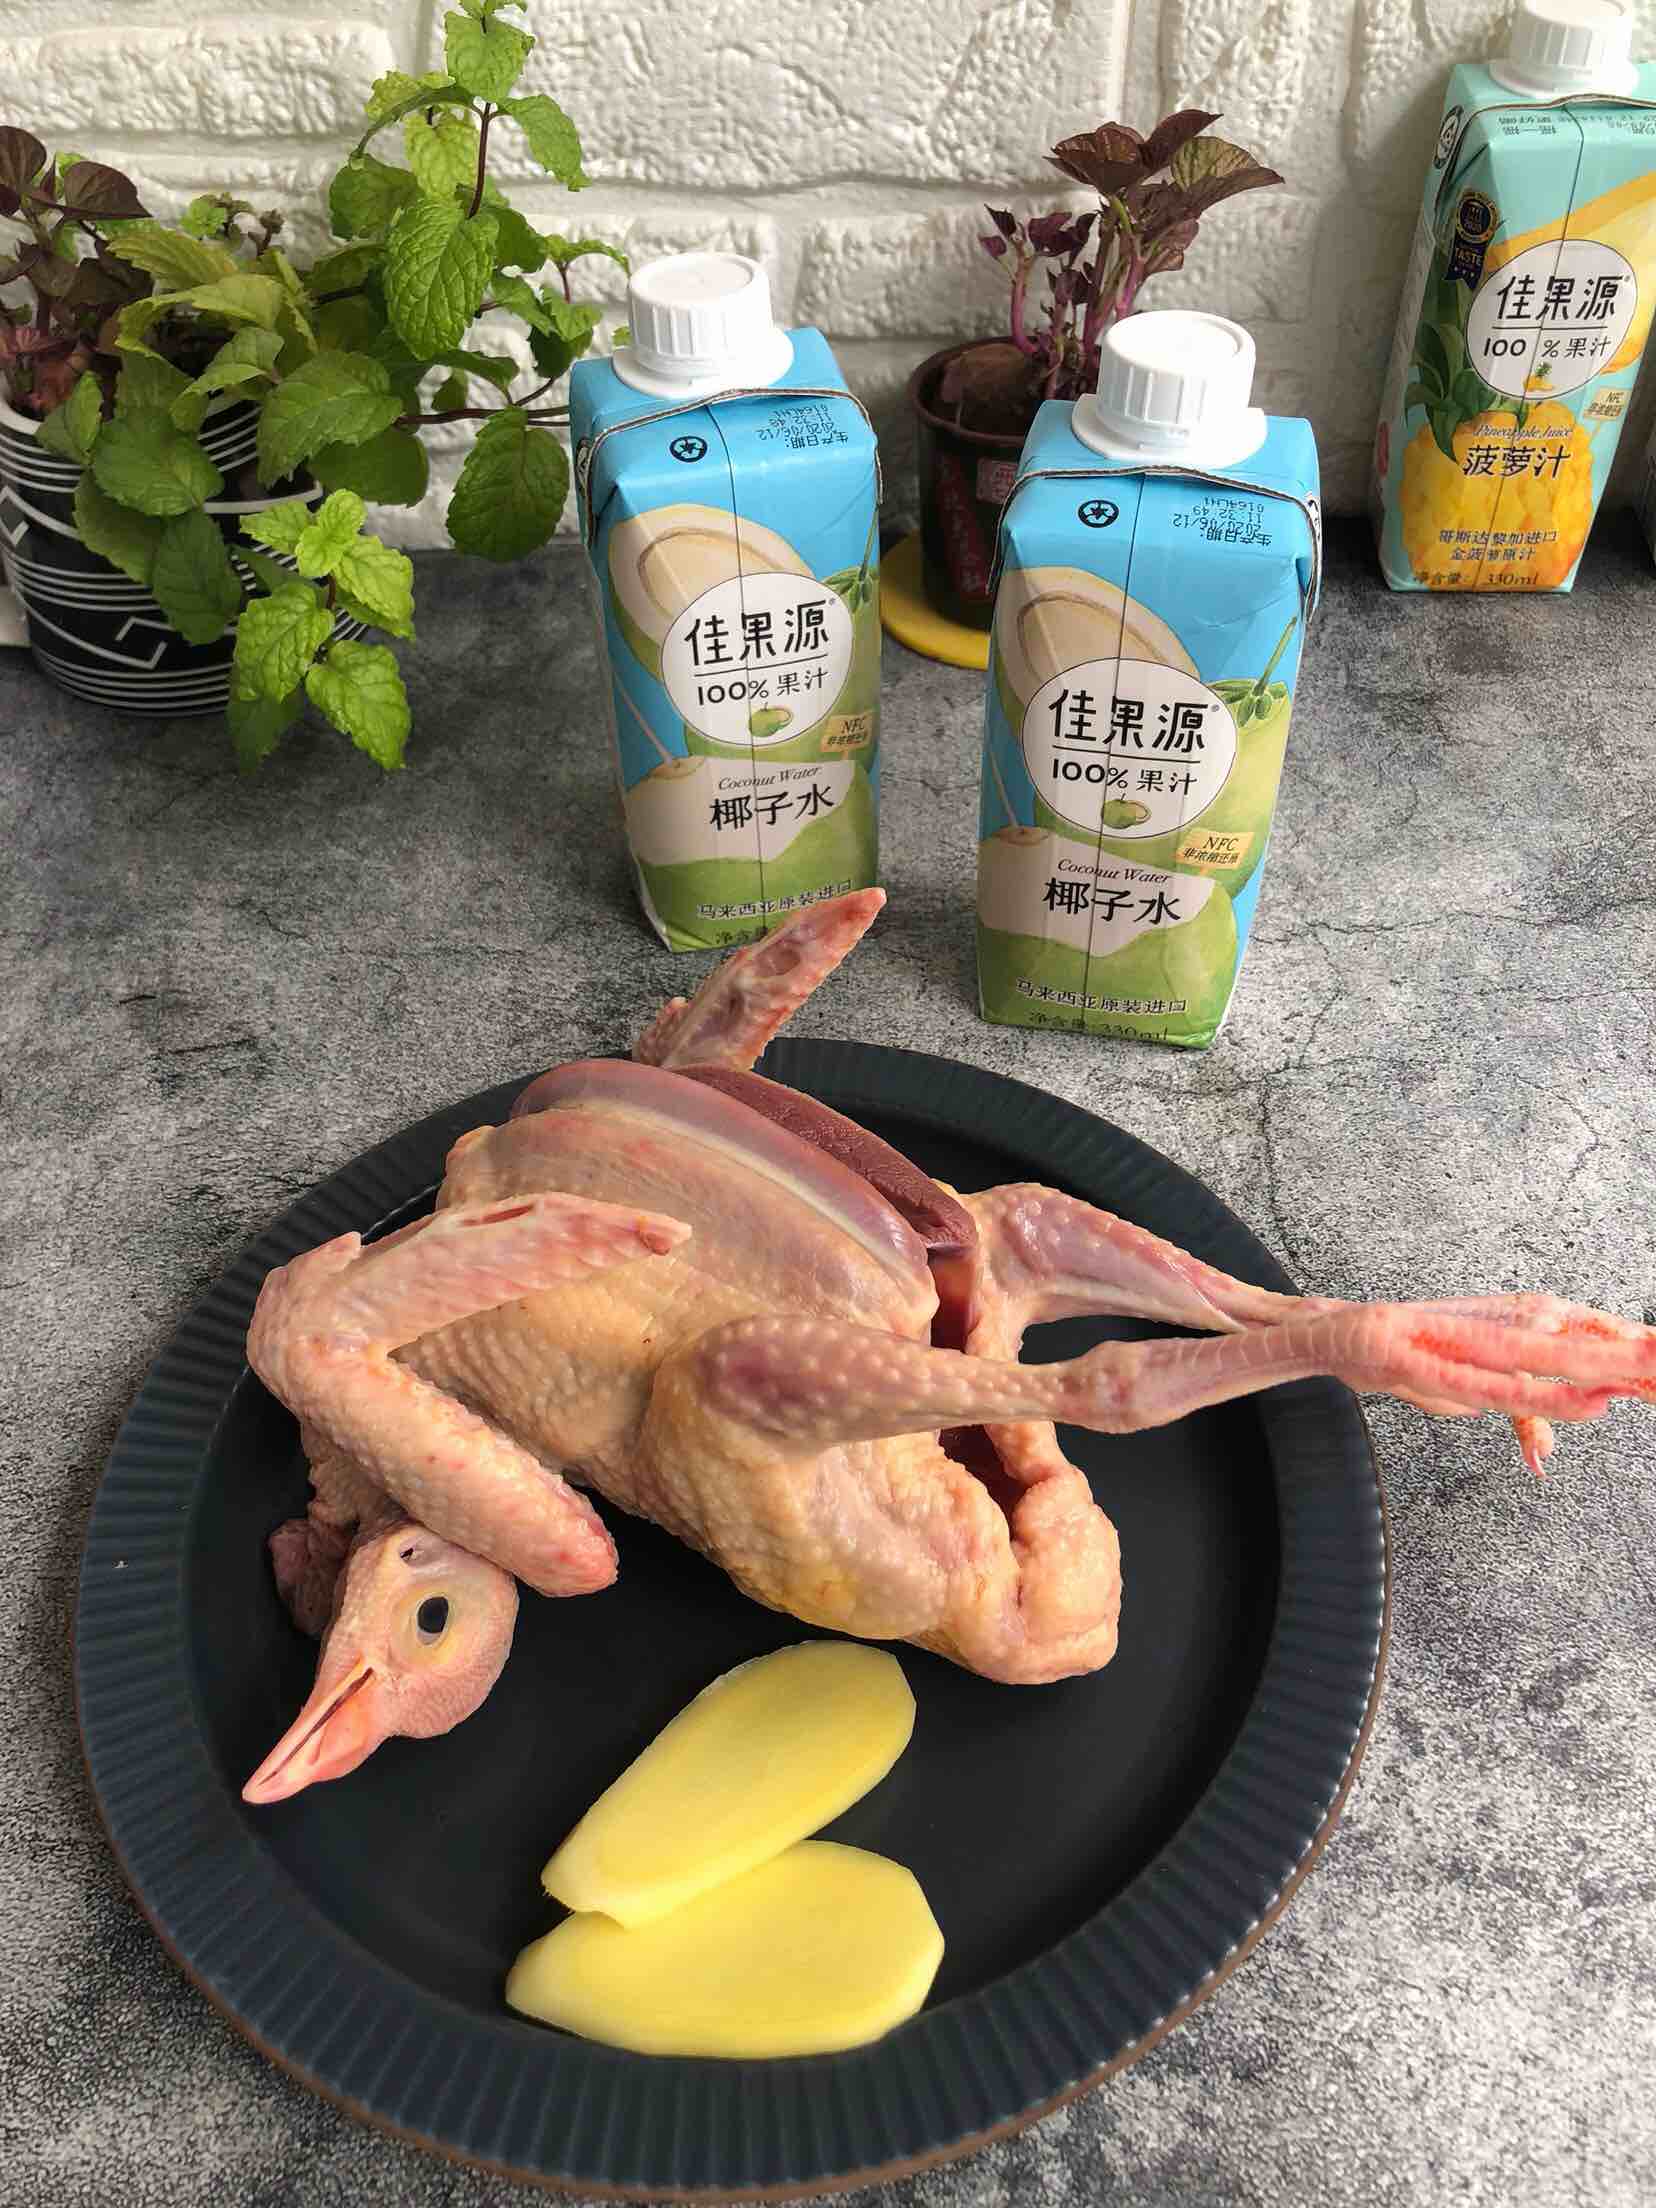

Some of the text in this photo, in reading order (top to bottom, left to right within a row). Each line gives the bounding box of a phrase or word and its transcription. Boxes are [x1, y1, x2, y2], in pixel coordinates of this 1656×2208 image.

[1497, 274, 1623, 321] 佳果源
[1464, 444, 1571, 478] 菠萝汁
[684, 600, 829, 666] 佳果源
[1048, 688, 1209, 753] 佳果源
[718, 765, 822, 792] Coconut Water
[709, 783, 835, 831] 椰子水
[1202, 836, 1240, 851] NFC
[1057, 858, 1170, 885] Coconut Water
[700, 879, 851, 919] 马来西亚原装进口
[1042, 877, 1181, 925] 椰子水
[1016, 977, 1187, 1014] 马来西亚原装进口
